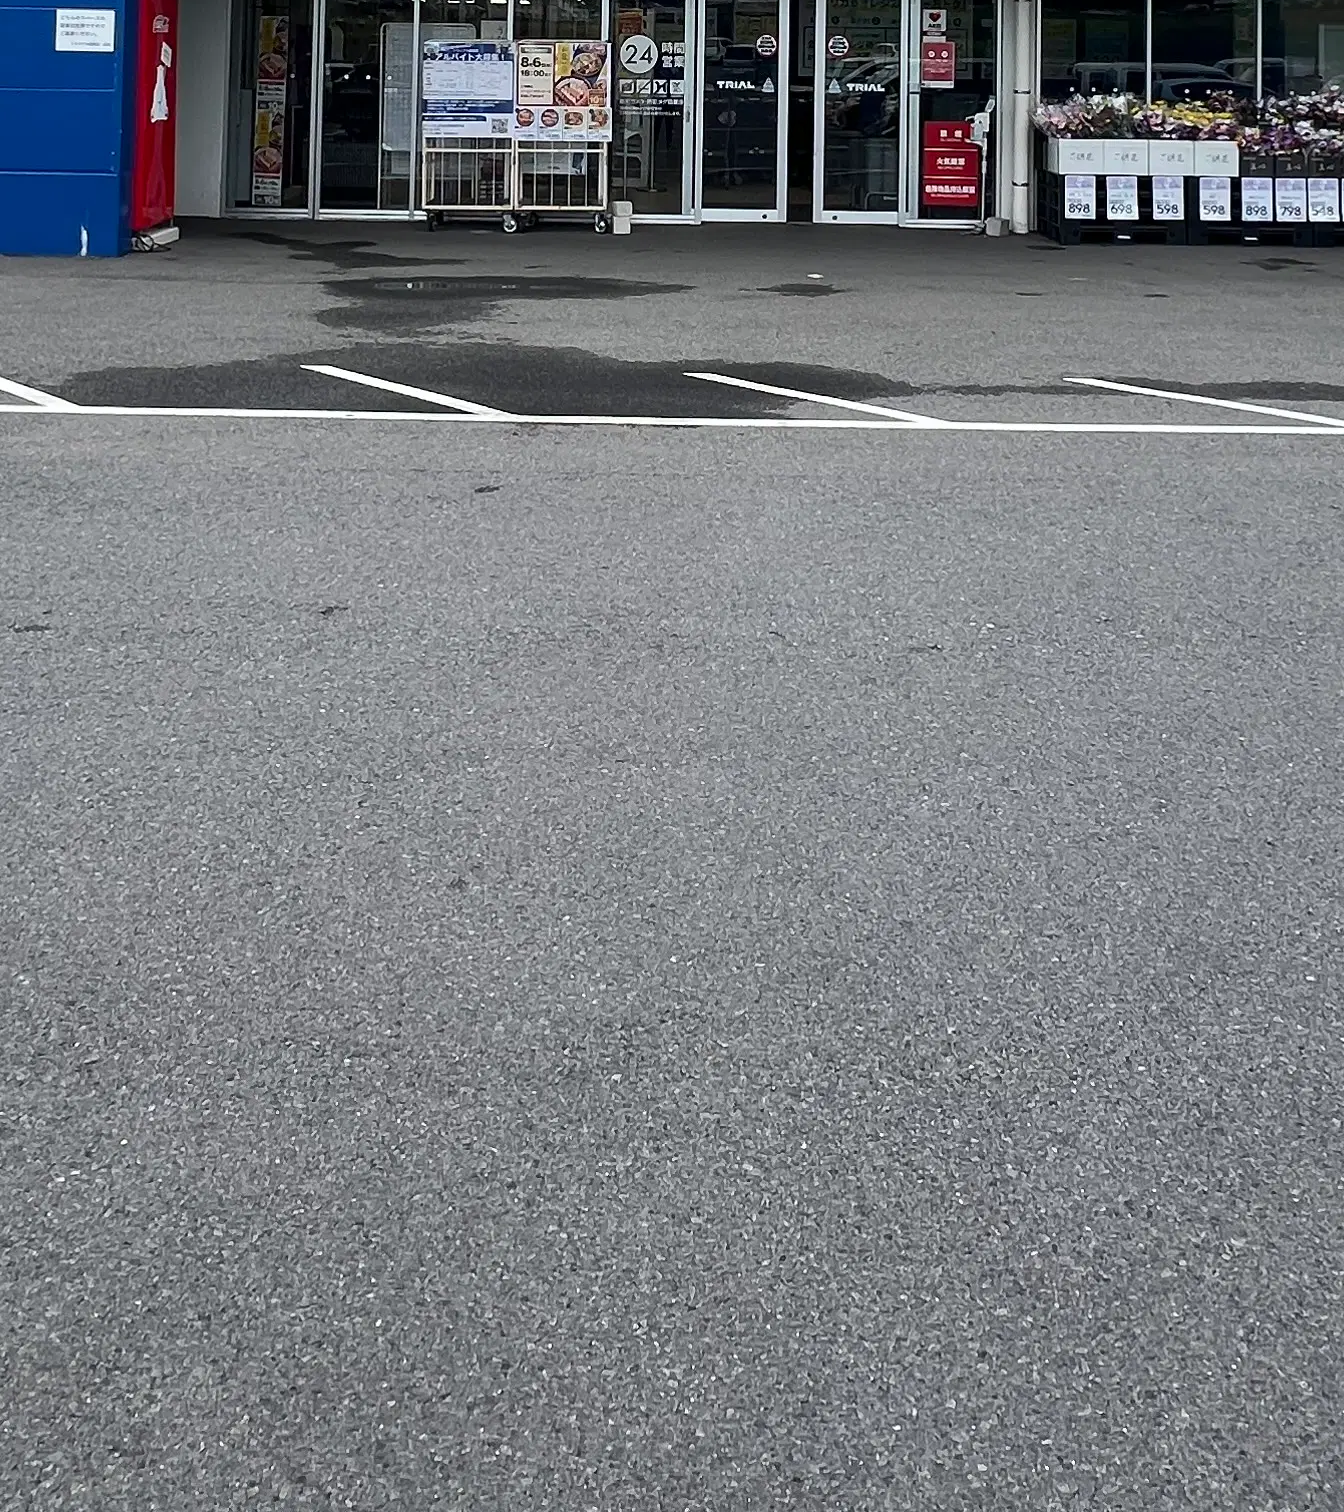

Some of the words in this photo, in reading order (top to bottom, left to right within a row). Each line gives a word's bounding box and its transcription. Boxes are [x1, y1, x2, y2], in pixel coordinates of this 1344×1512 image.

[661, 42, 685, 54] 時間
[625, 44, 654, 65] 24
[716, 80, 755, 89] TRIAL
[846, 83, 885, 92] TRIAL
[1068, 203, 1090, 214] 898
[1110, 203, 1133, 214] 698
[1156, 204, 1179, 215] 598
[1203, 205, 1226, 216] 598
[1245, 205, 1268, 216] 898
[1280, 206, 1302, 217] 798
[1311, 206, 1334, 217] 548
